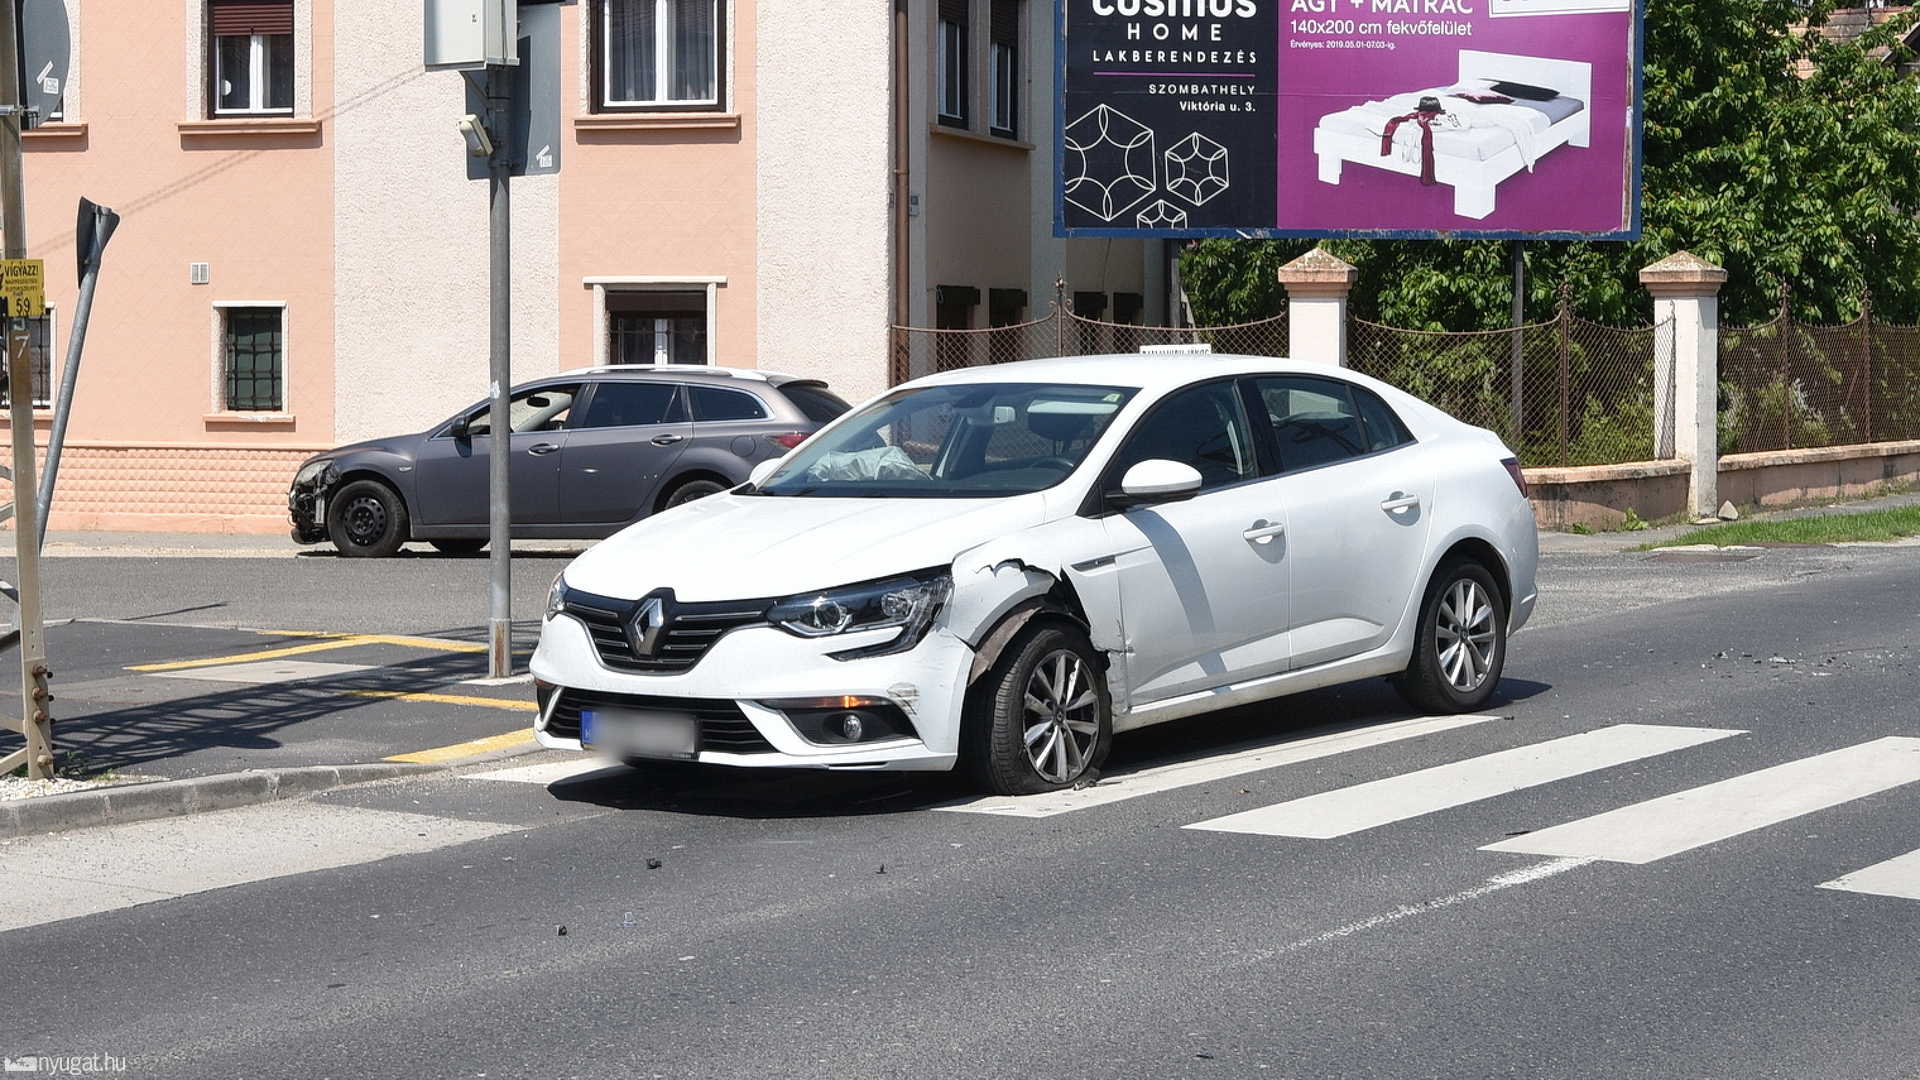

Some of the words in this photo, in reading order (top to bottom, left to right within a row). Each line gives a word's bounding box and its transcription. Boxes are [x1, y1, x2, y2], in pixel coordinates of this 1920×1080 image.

[1127, 22, 1222, 42] HOME
[1290, 19, 1355, 35] 140x200
[1358, 23, 1383, 35] cm
[1386, 20, 1473, 36] fekvőfelület
[1092, 49, 1257, 64] LAKBERENDEZÉS
[1148, 84, 1256, 96] SZOMBATHELY
[1179, 101, 1226, 112] Viktória
[1229, 103, 1241, 112] u.
[1244, 102, 1256, 112] 3.
[14, 334, 30, 359] 7
